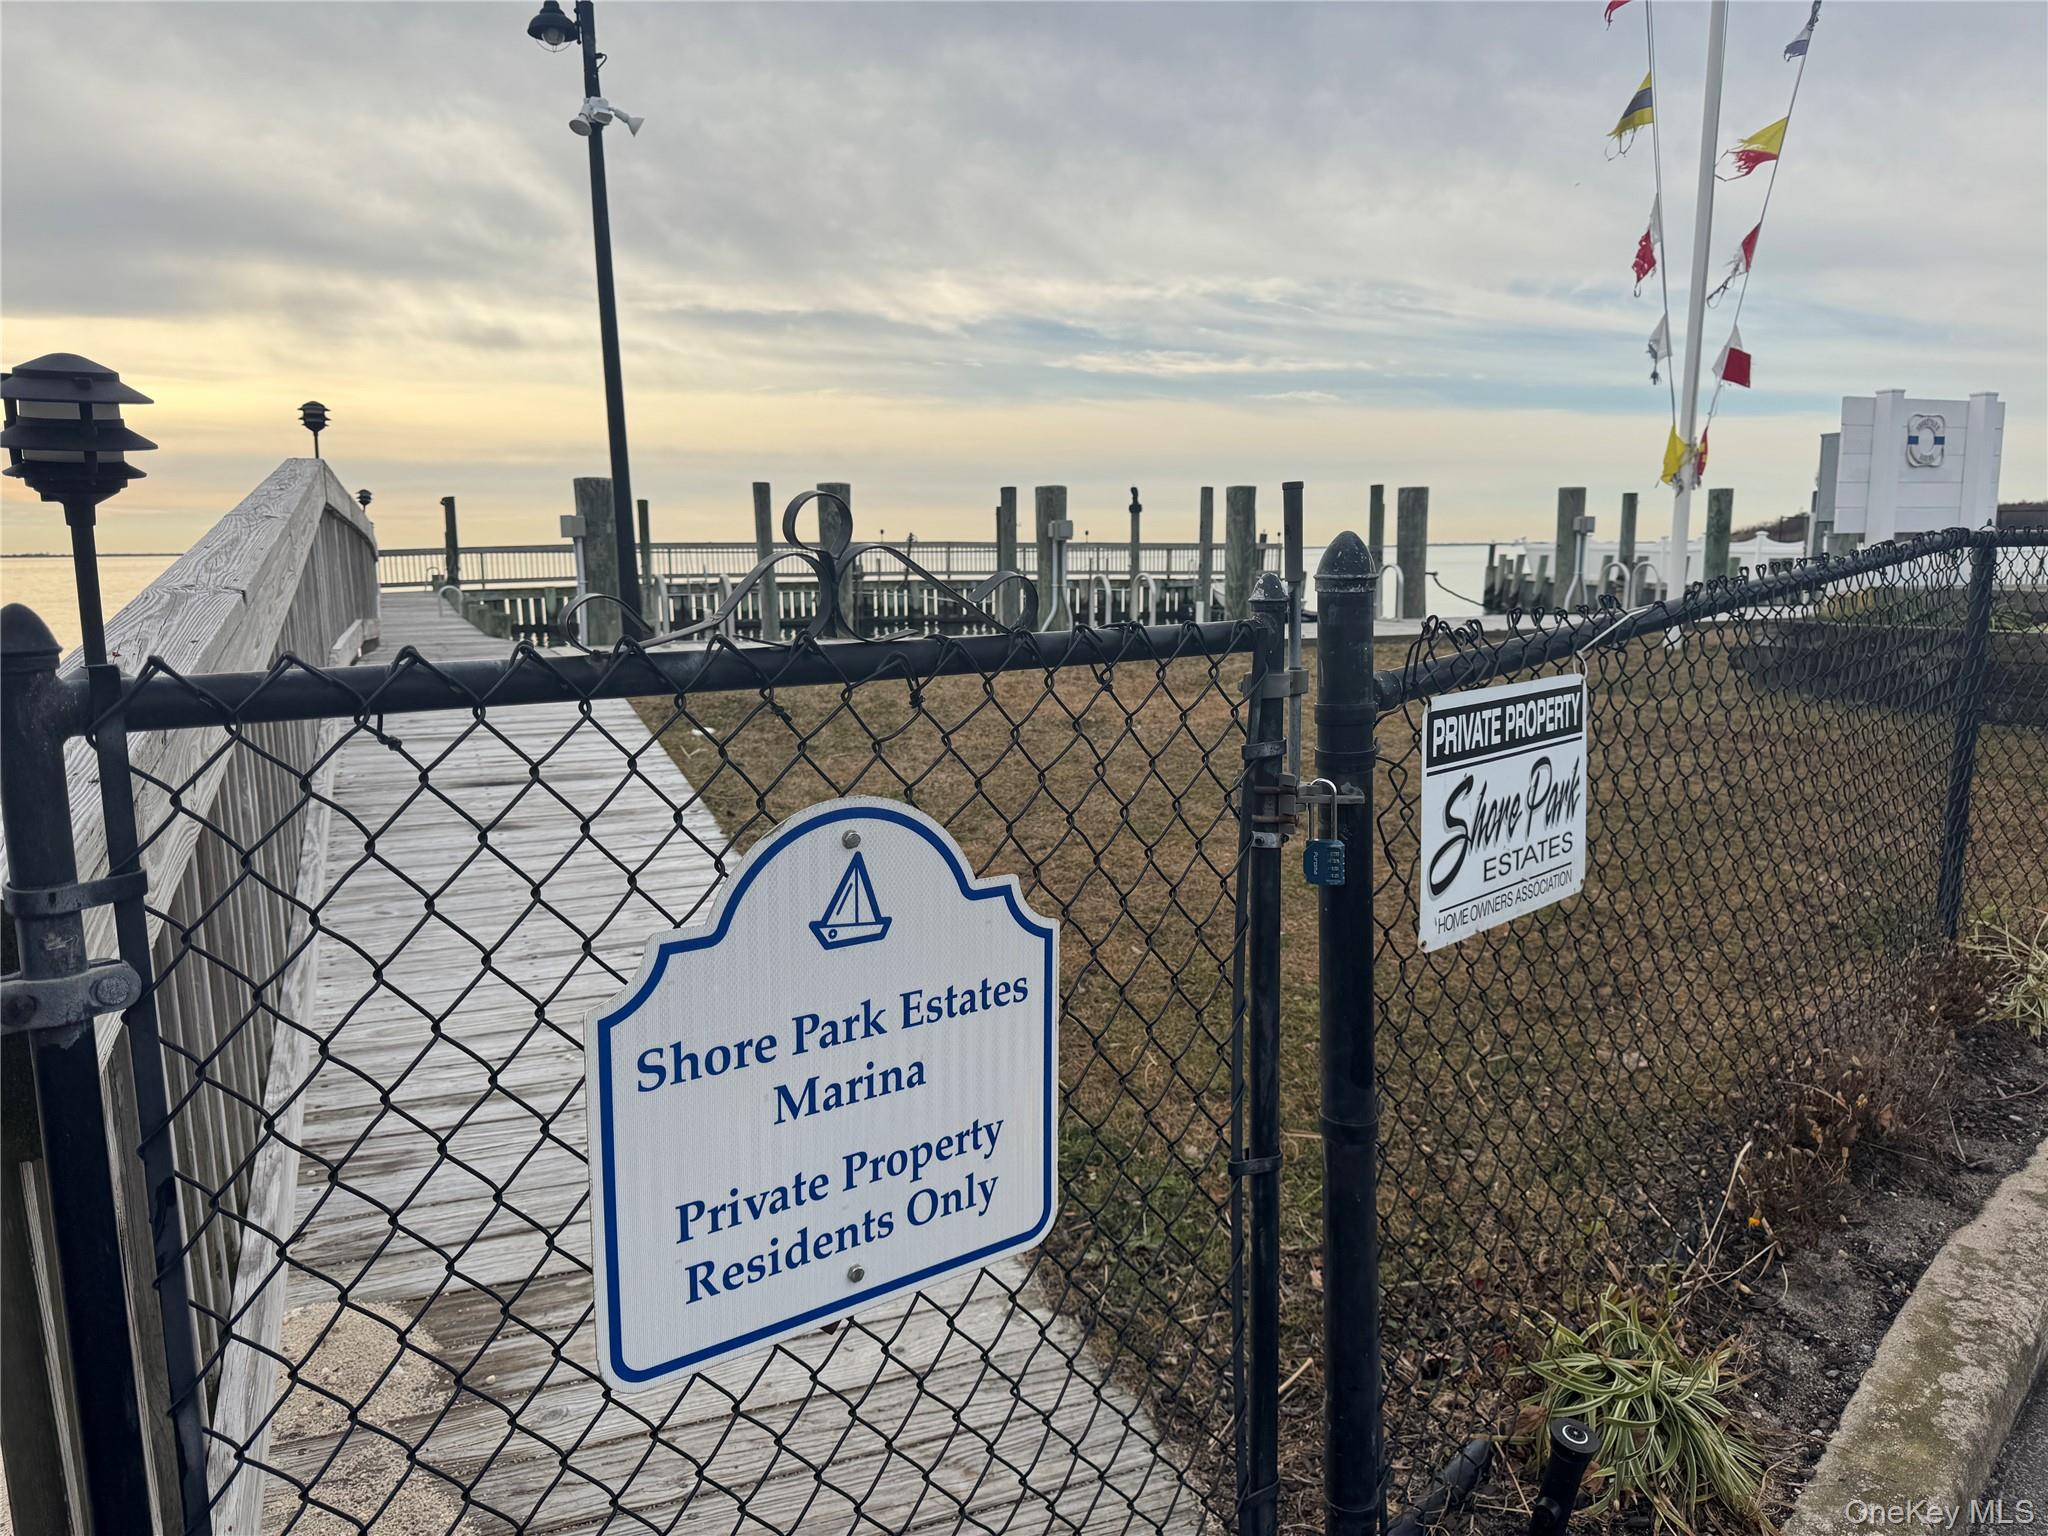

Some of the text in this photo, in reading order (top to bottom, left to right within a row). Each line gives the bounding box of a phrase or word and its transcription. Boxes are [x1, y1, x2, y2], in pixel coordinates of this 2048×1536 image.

[1432, 692, 1581, 757] PRIVATE PROPERTY
[1428, 755, 1581, 896] Shore Park
[1483, 831, 1573, 882] ESTATES
[1470, 892, 1513, 922] OWNERS
[1514, 869, 1573, 902] ASSOCIATION
[636, 976, 1029, 1092] Shore Park Estates
[773, 1060, 927, 1125] Marina
[675, 1119, 1004, 1243] Private Property
[685, 1172, 999, 1305] Residents Only
